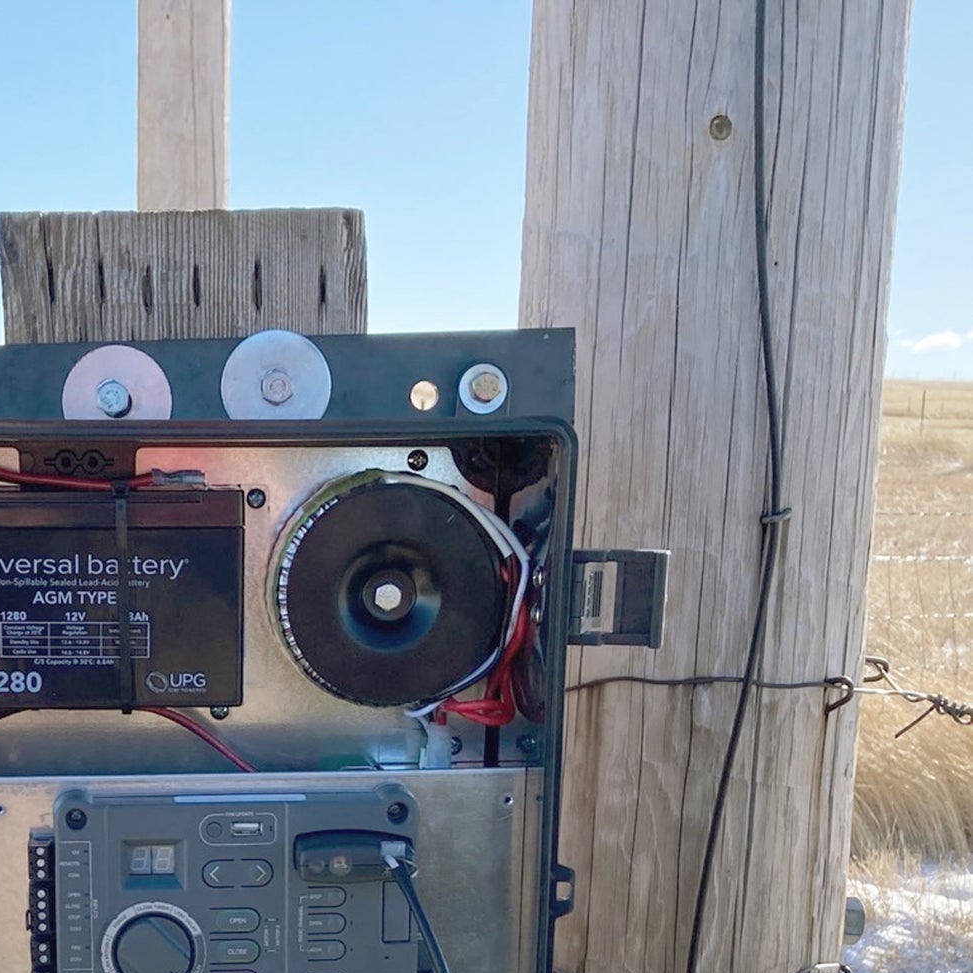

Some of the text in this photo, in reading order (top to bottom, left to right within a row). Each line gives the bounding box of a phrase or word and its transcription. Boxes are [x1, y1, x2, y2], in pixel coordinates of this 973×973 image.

[87, 553, 185, 579] batery
[49, 578, 76, 587] Sealed
[32, 591, 117, 605] AGM TYPE
[0, 611, 27, 621] 1280
[65, 611, 86, 621] 12V
[169, 672, 206, 688] UPG
